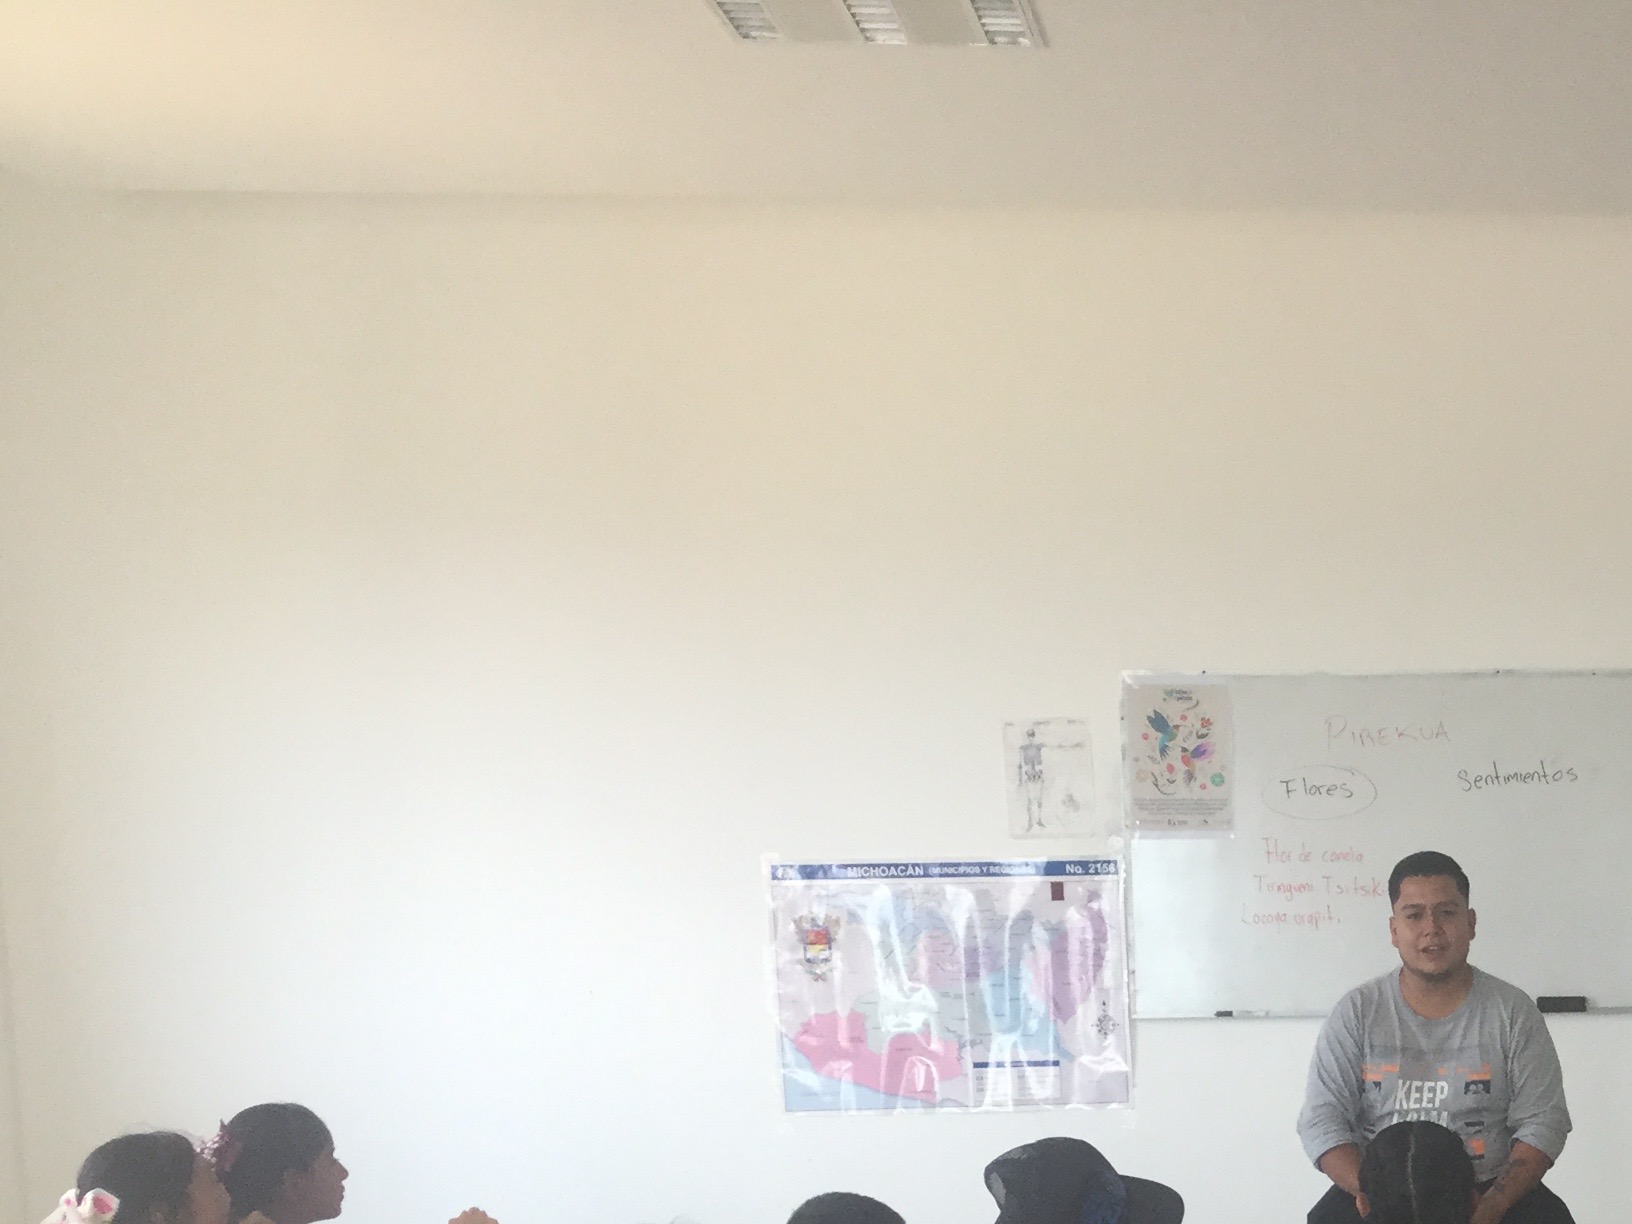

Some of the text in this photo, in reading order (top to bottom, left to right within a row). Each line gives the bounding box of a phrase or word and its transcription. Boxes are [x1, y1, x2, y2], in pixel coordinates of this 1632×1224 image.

[1279, 776, 1355, 799] Flores
[846, 863, 925, 878] MICHOACÁN
[1394, 1078, 1450, 1110] KEEP
